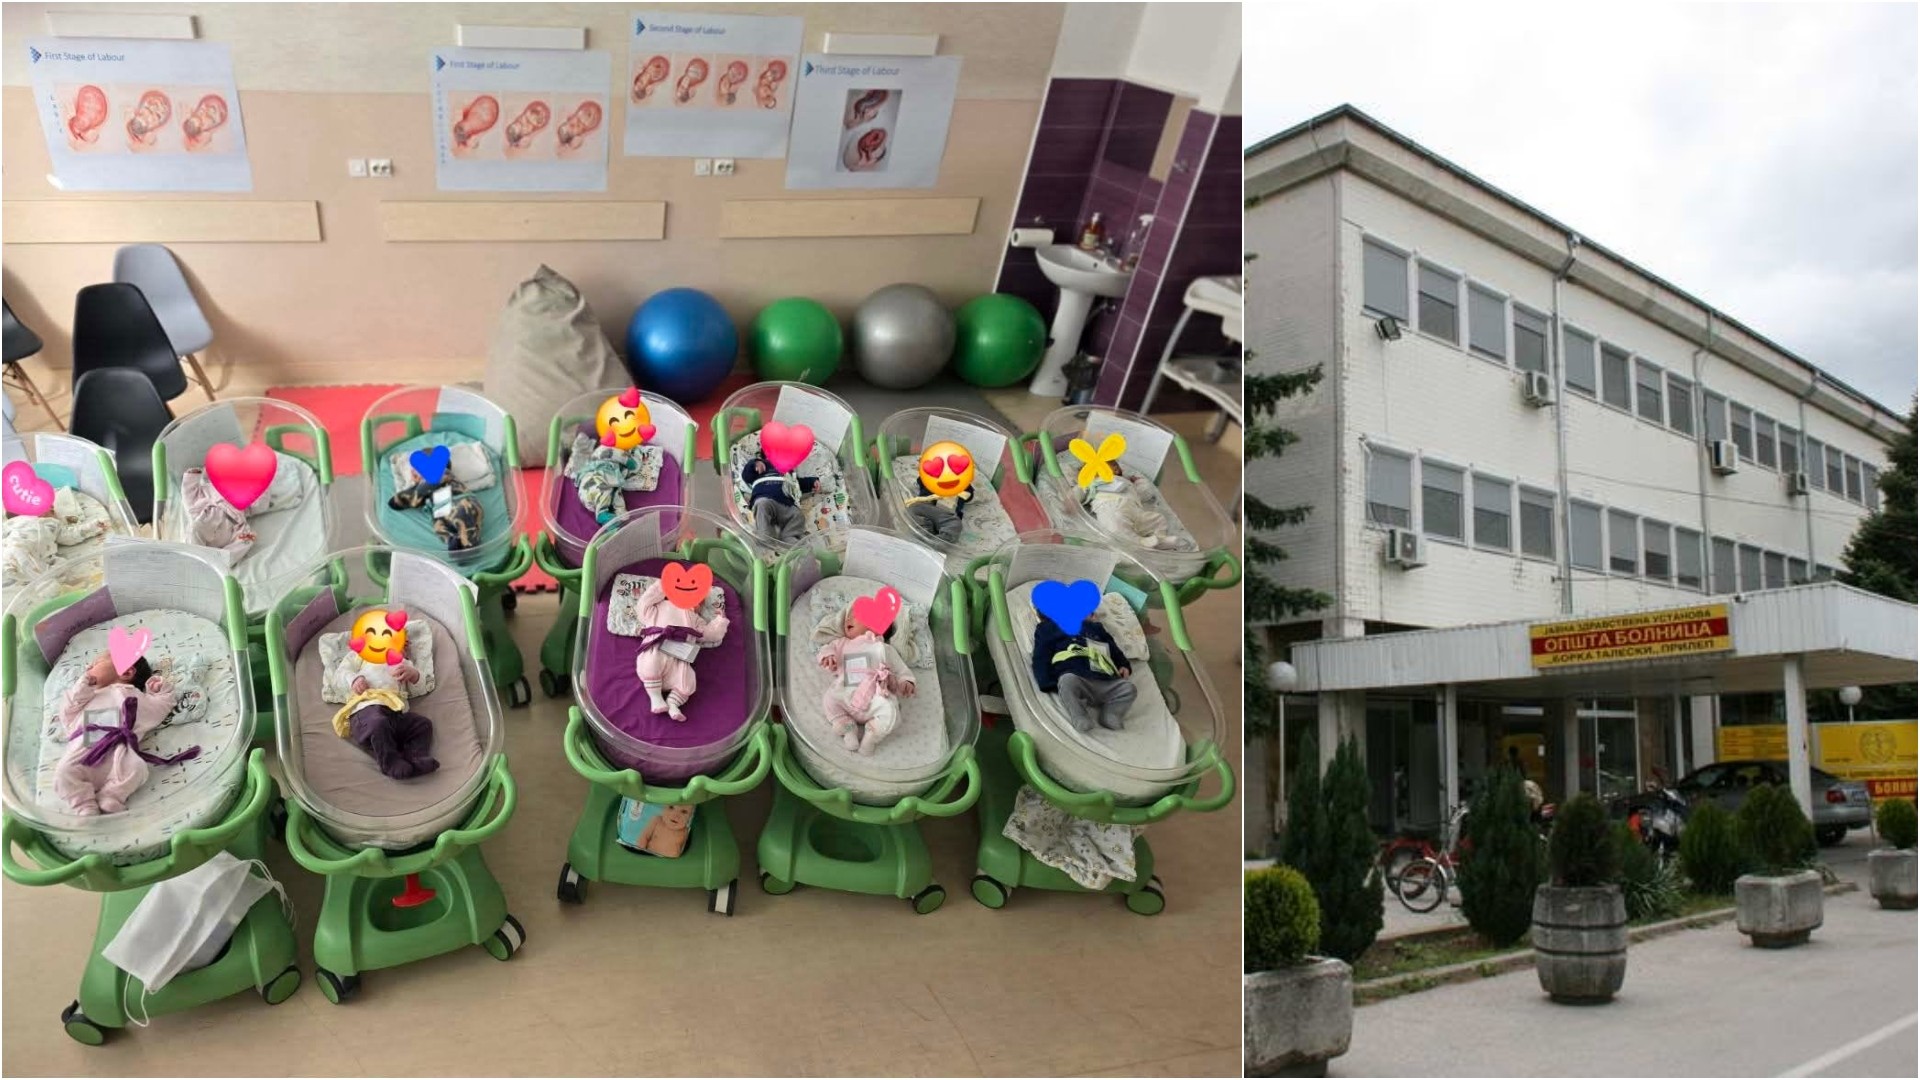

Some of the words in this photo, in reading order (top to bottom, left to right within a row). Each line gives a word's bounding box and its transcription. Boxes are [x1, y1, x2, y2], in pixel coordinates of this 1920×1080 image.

[649, 24, 674, 33] Second
[675, 25, 693, 35] Stage
[703, 26, 726, 35] Labour
[44, 51, 62, 60] First
[64, 52, 86, 62] Stage
[87, 53, 96, 61] of
[98, 53, 125, 62] Labour
[449, 60, 465, 69] First
[466, 61, 485, 71] Stage
[486, 61, 495, 69] of
[496, 62, 520, 70] Labour
[815, 65, 837, 75] Third
[838, 66, 861, 77] Stage
[862, 66, 872, 75] of
[872, 67, 900, 76] Labour
[1653, 608, 1711, 623] УСТАНОВА
[1544, 631, 1611, 652] ОПШТА
[1614, 621, 1712, 645] БОЛНИЦА
